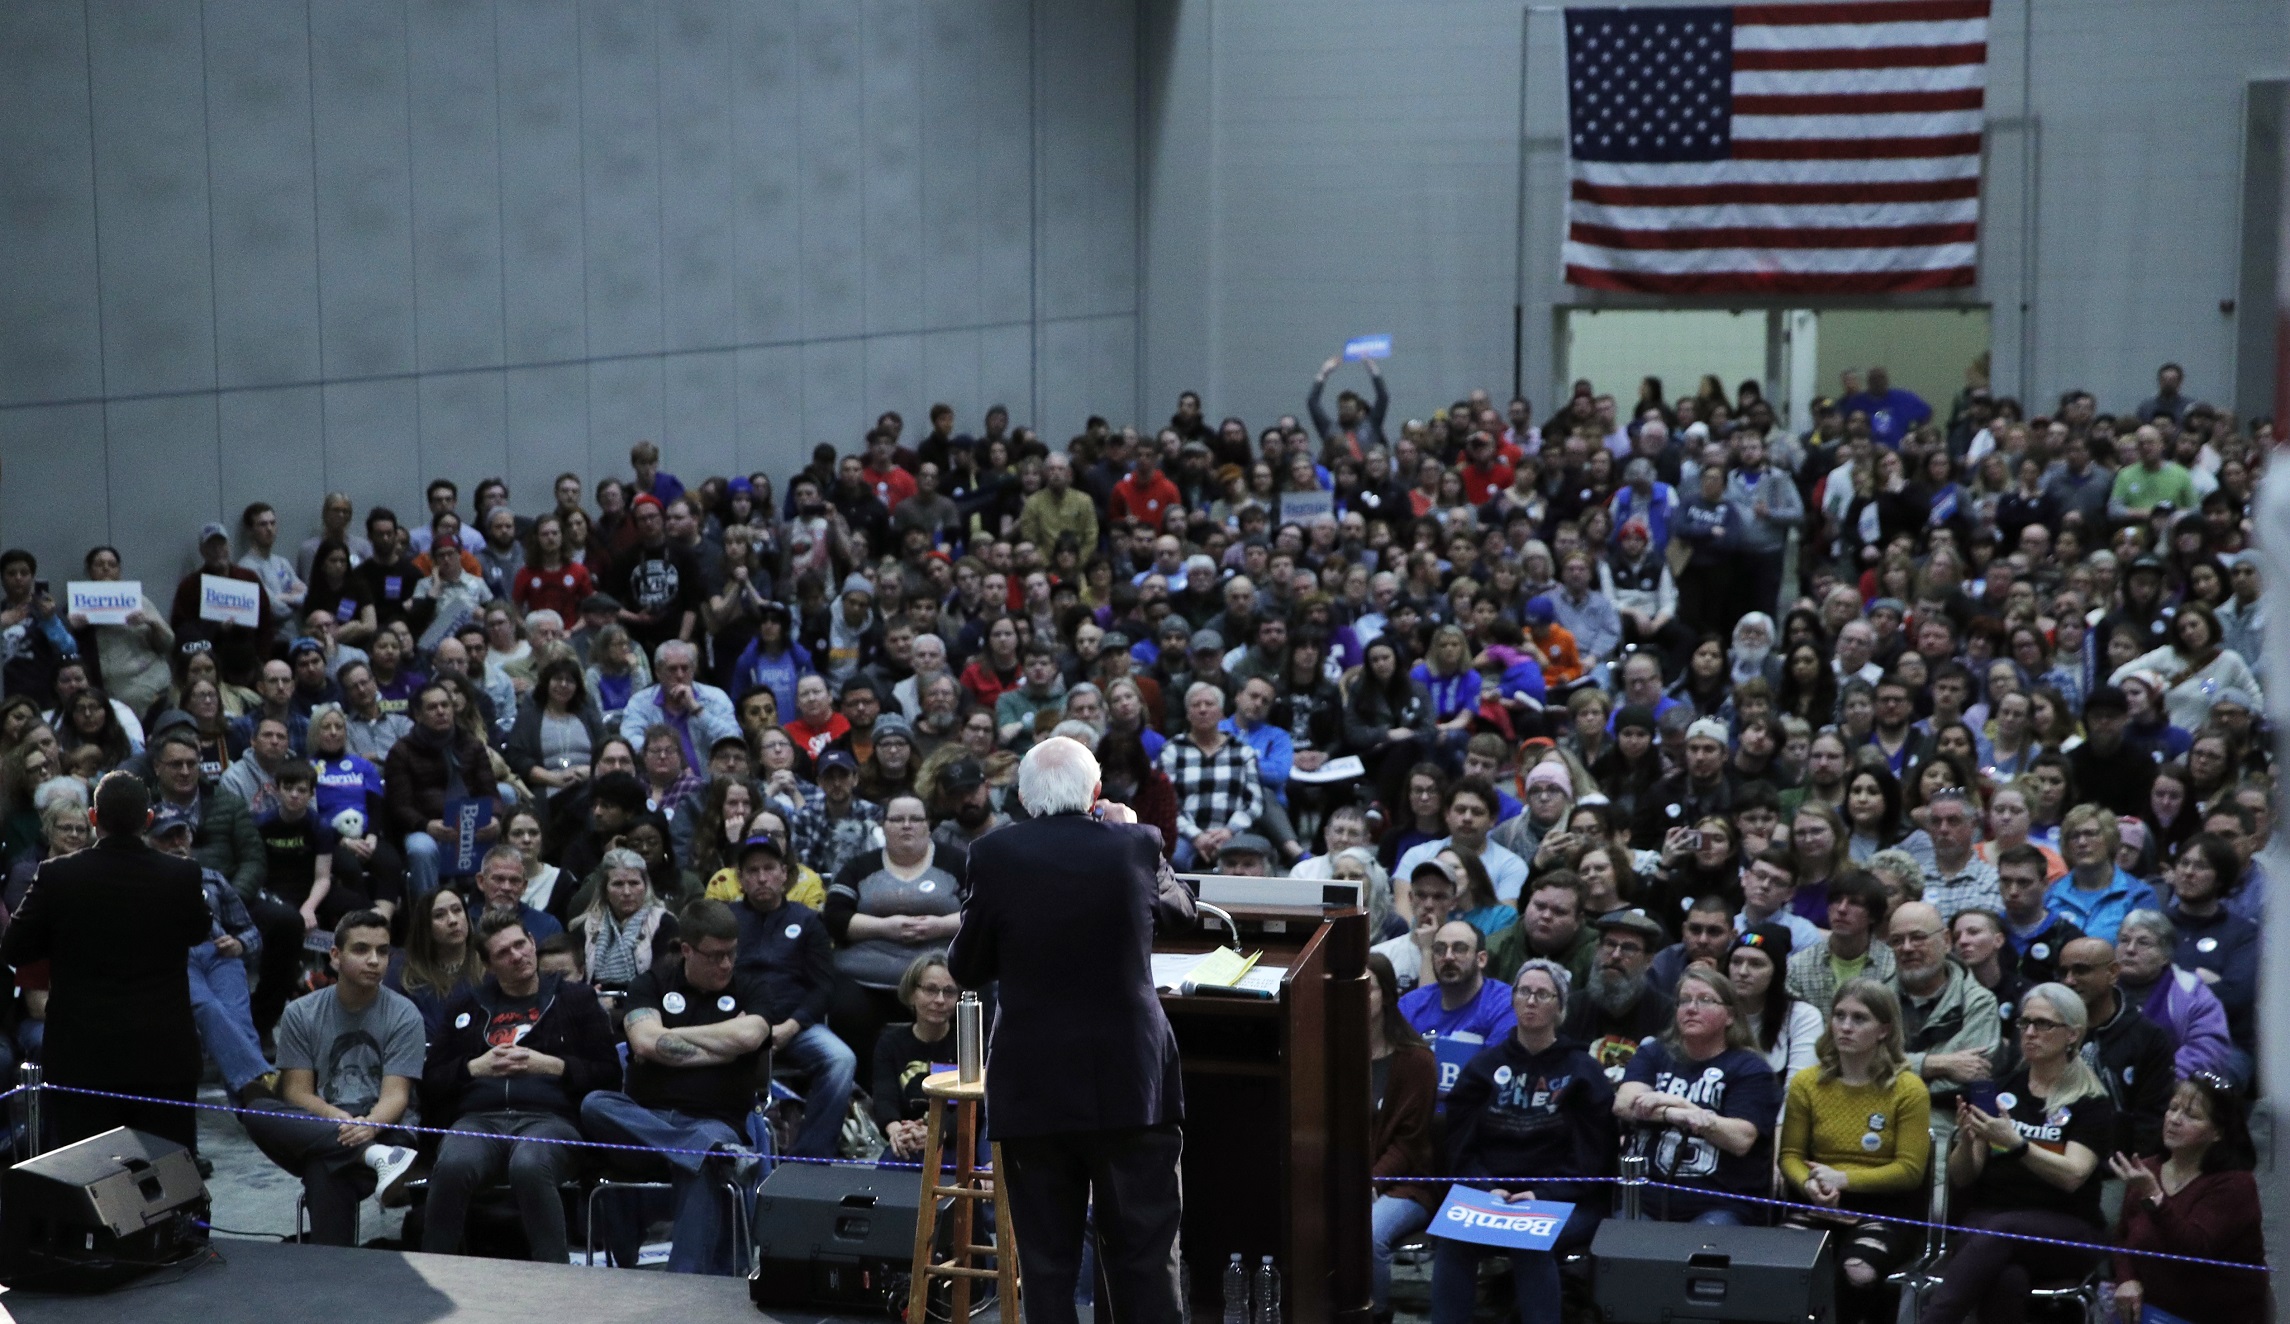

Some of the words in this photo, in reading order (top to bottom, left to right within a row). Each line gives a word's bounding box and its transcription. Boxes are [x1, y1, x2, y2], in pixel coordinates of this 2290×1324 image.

[74, 592, 137, 608] Bernie
[206, 587, 255, 608] Bernie
[458, 803, 479, 870] Bernie
[2010, 1119, 2062, 1142] rnie
[1446, 1205, 1559, 1237] Bernie
